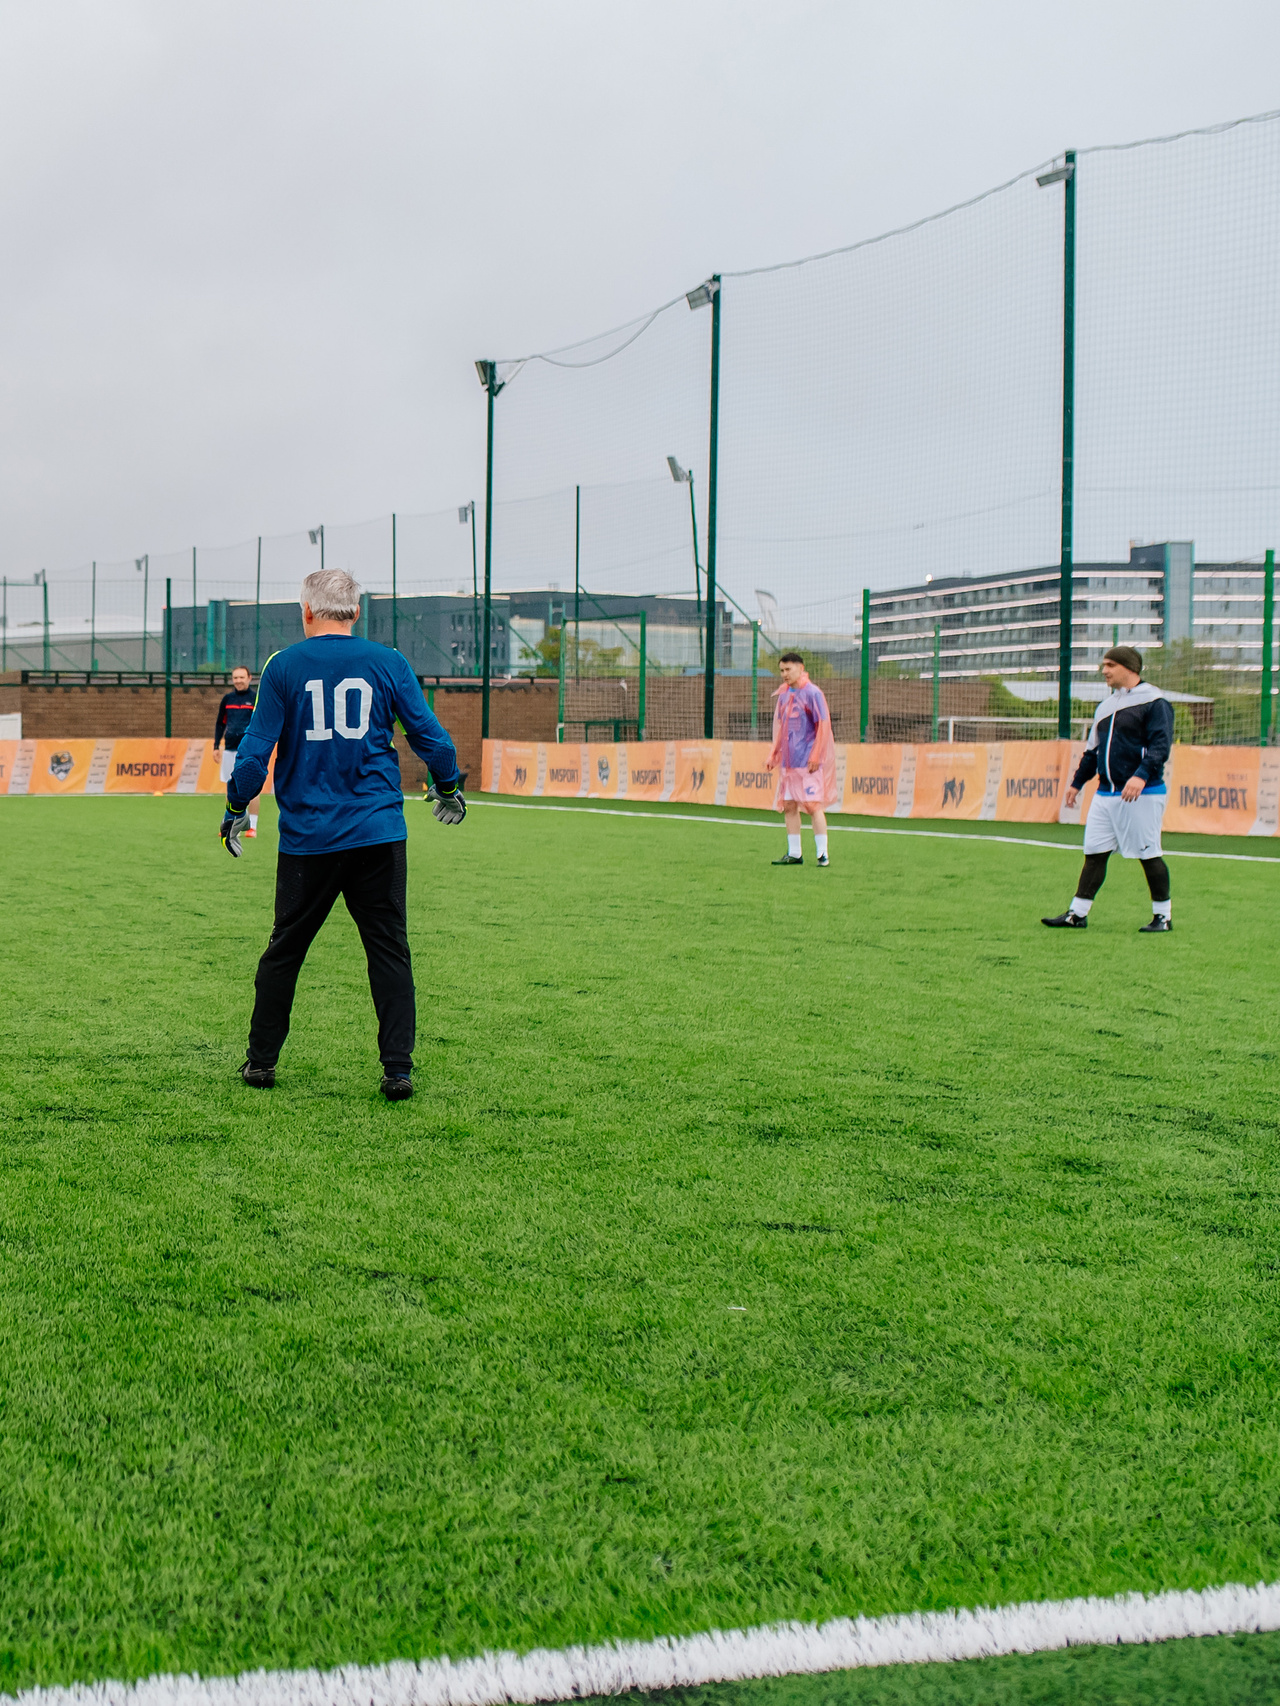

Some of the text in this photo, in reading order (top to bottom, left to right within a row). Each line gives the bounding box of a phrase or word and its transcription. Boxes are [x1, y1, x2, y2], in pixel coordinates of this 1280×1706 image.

[304, 677, 373, 741] 10
[116, 763, 175, 777] IMSPORT
[549, 768, 579, 783] IMSPORT
[631, 769, 662, 785] IMSPORT
[734, 771, 773, 789] IMSPORT
[851, 776, 894, 796] IMSPORT
[1006, 778, 1060, 798] IMSPORT
[1179, 785, 1248, 811] IMSPORT
